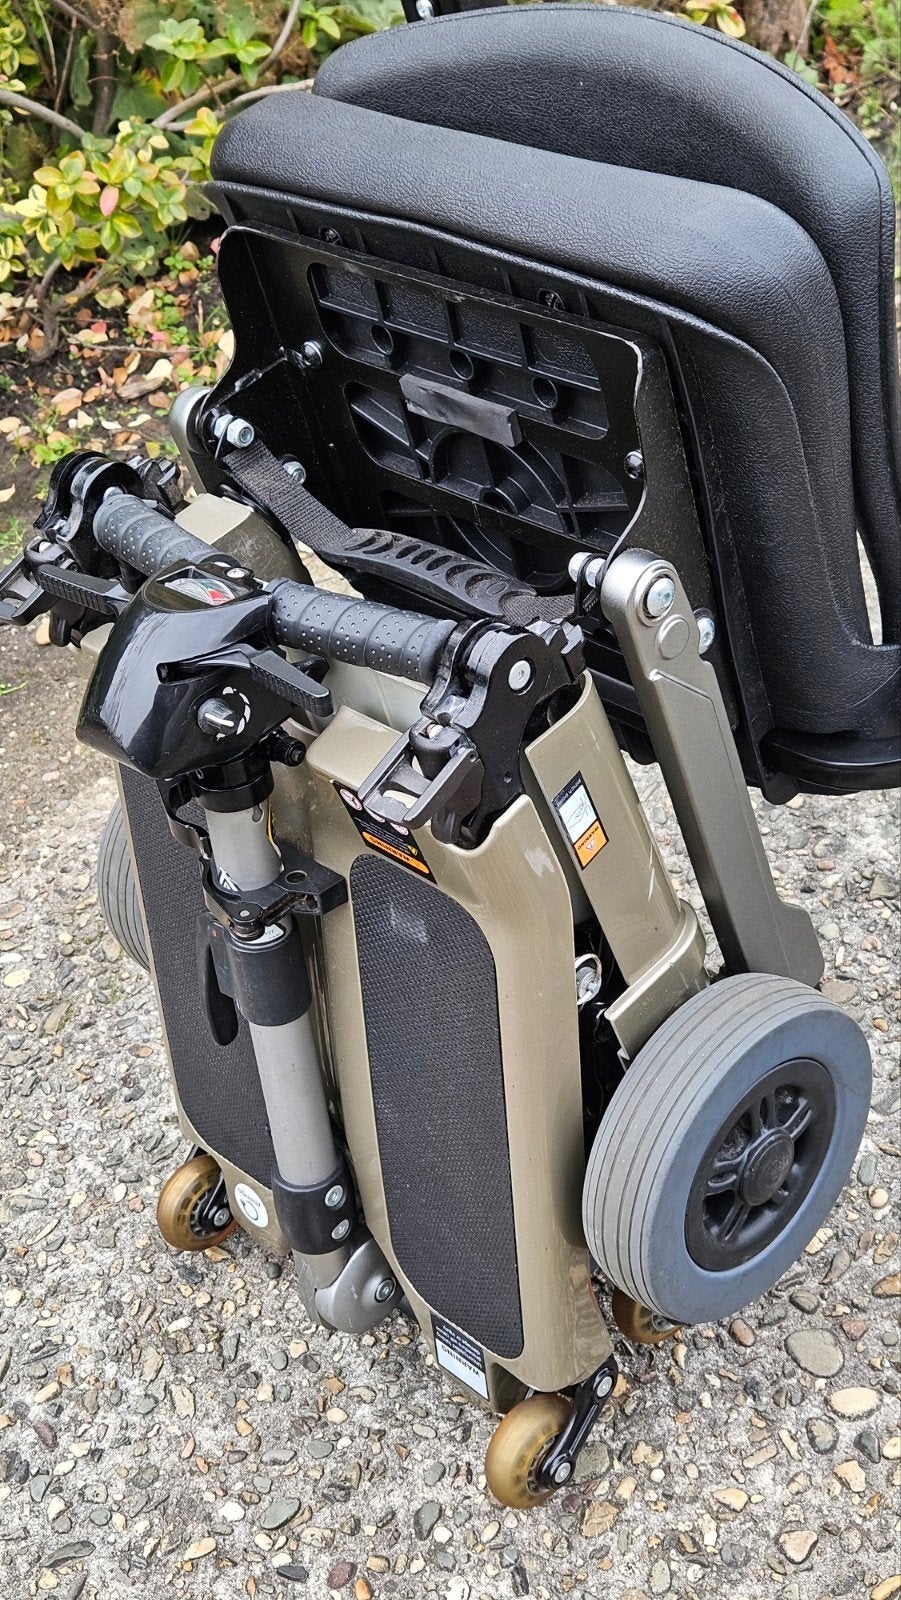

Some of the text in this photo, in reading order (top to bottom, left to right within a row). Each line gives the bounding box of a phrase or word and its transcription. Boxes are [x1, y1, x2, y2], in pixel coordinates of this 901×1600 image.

[568, 778, 582, 795] pinch
[556, 792, 569, 807] point
[369, 837, 410, 862] WARNING
[577, 826, 599, 850] WARNING
[441, 1345, 480, 1377] WARNING
